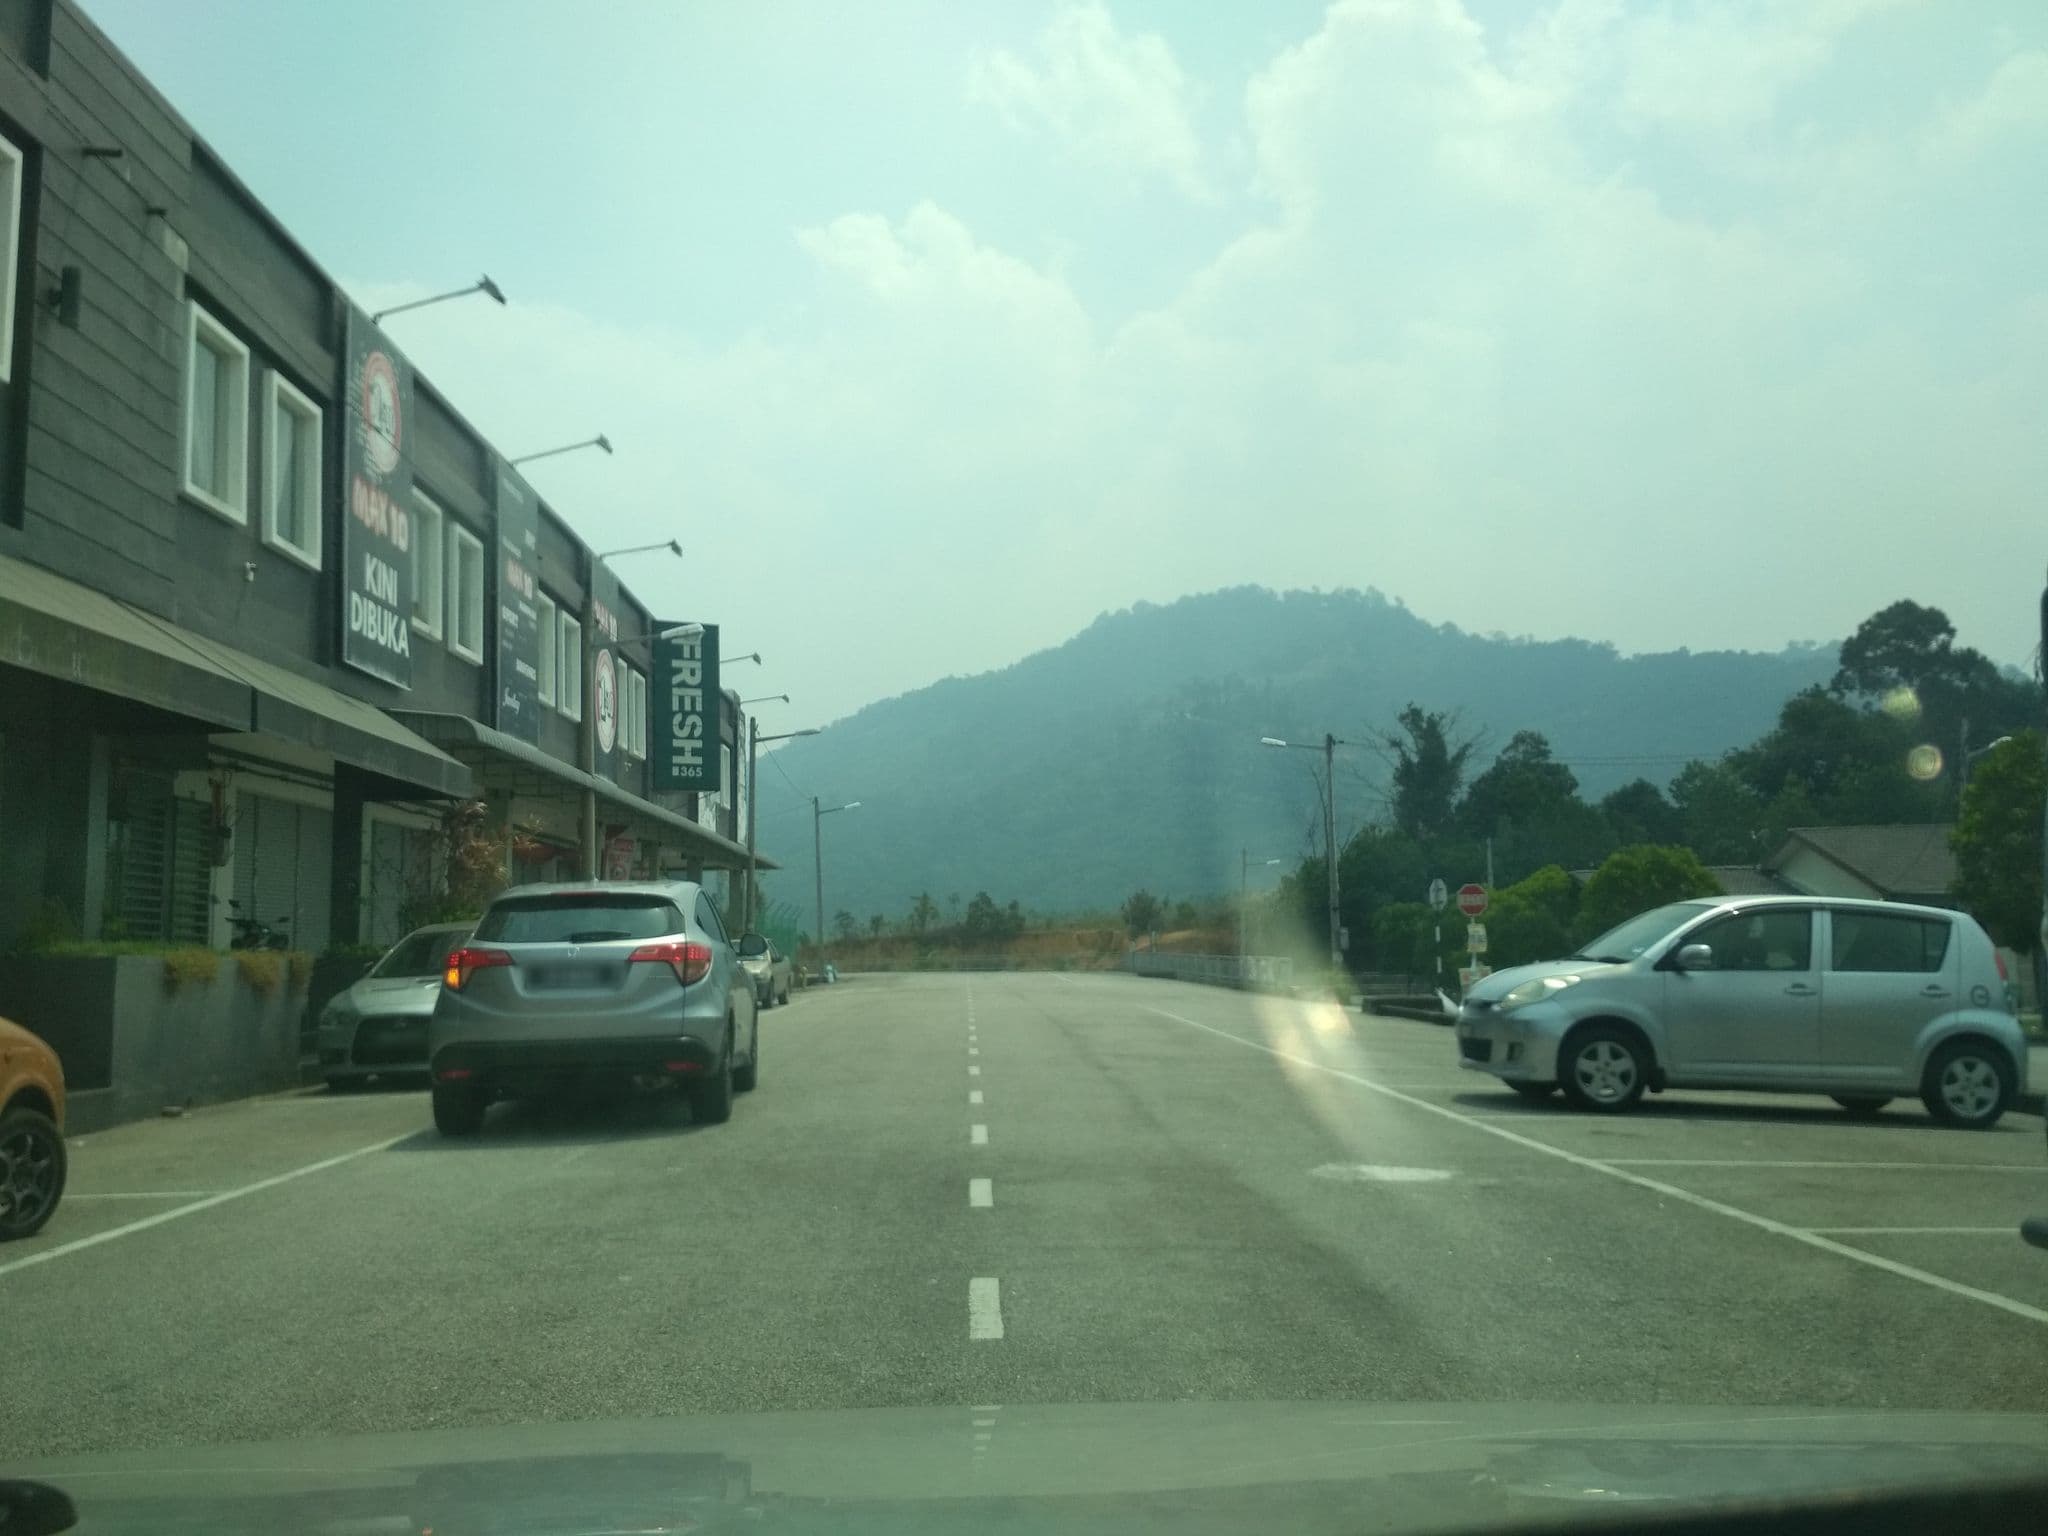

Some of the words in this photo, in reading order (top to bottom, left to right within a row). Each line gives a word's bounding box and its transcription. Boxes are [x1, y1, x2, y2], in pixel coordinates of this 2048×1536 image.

[365, 551, 398, 608] KINI
[350, 588, 411, 660] DIBUKA
[671, 636, 703, 765] FRESH
[680, 766, 703, 776] 365
